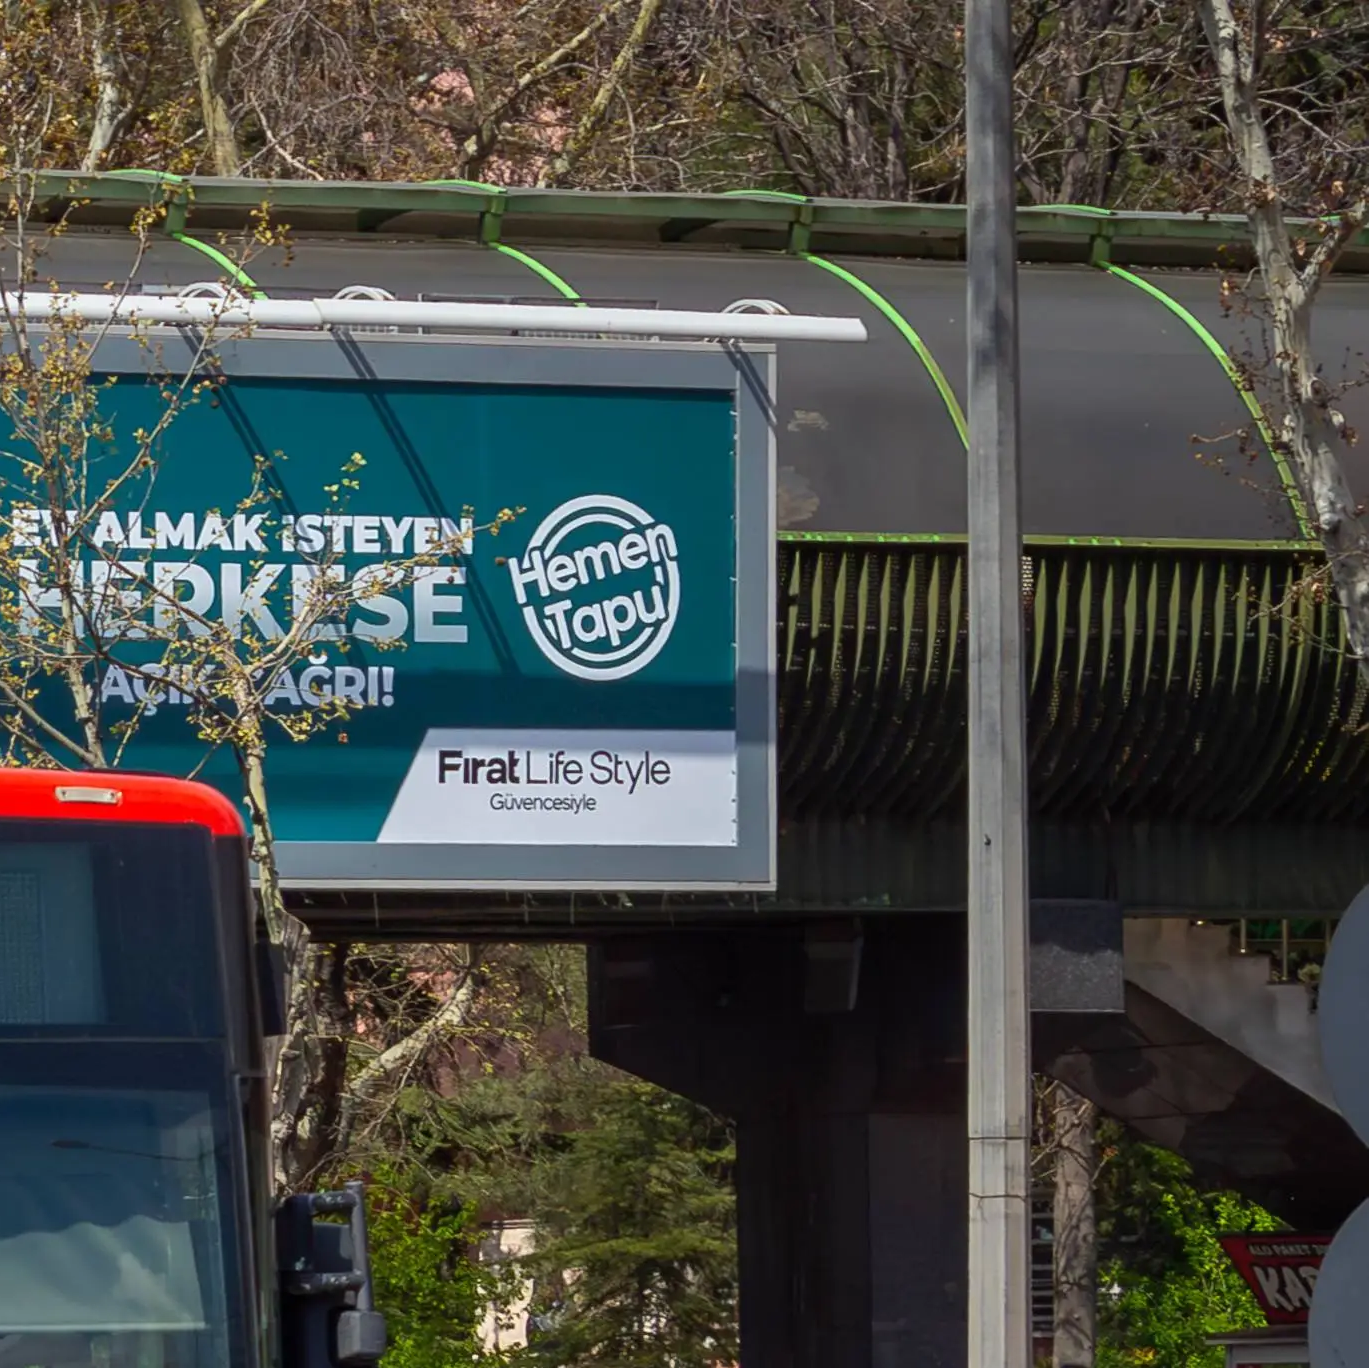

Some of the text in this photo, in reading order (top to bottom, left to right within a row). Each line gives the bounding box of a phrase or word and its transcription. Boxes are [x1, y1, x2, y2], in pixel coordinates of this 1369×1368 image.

[92, 510, 262, 550] ALMAK
[507, 522, 678, 605] Hemen
[17, 558, 469, 643] HERKESE
[544, 584, 667, 650] Tapu
[243, 655, 395, 708] AĞRI!
[526, 749, 584, 785] Life
[590, 750, 672, 795] Style
[489, 793, 597, 814] Güvencesiyle
